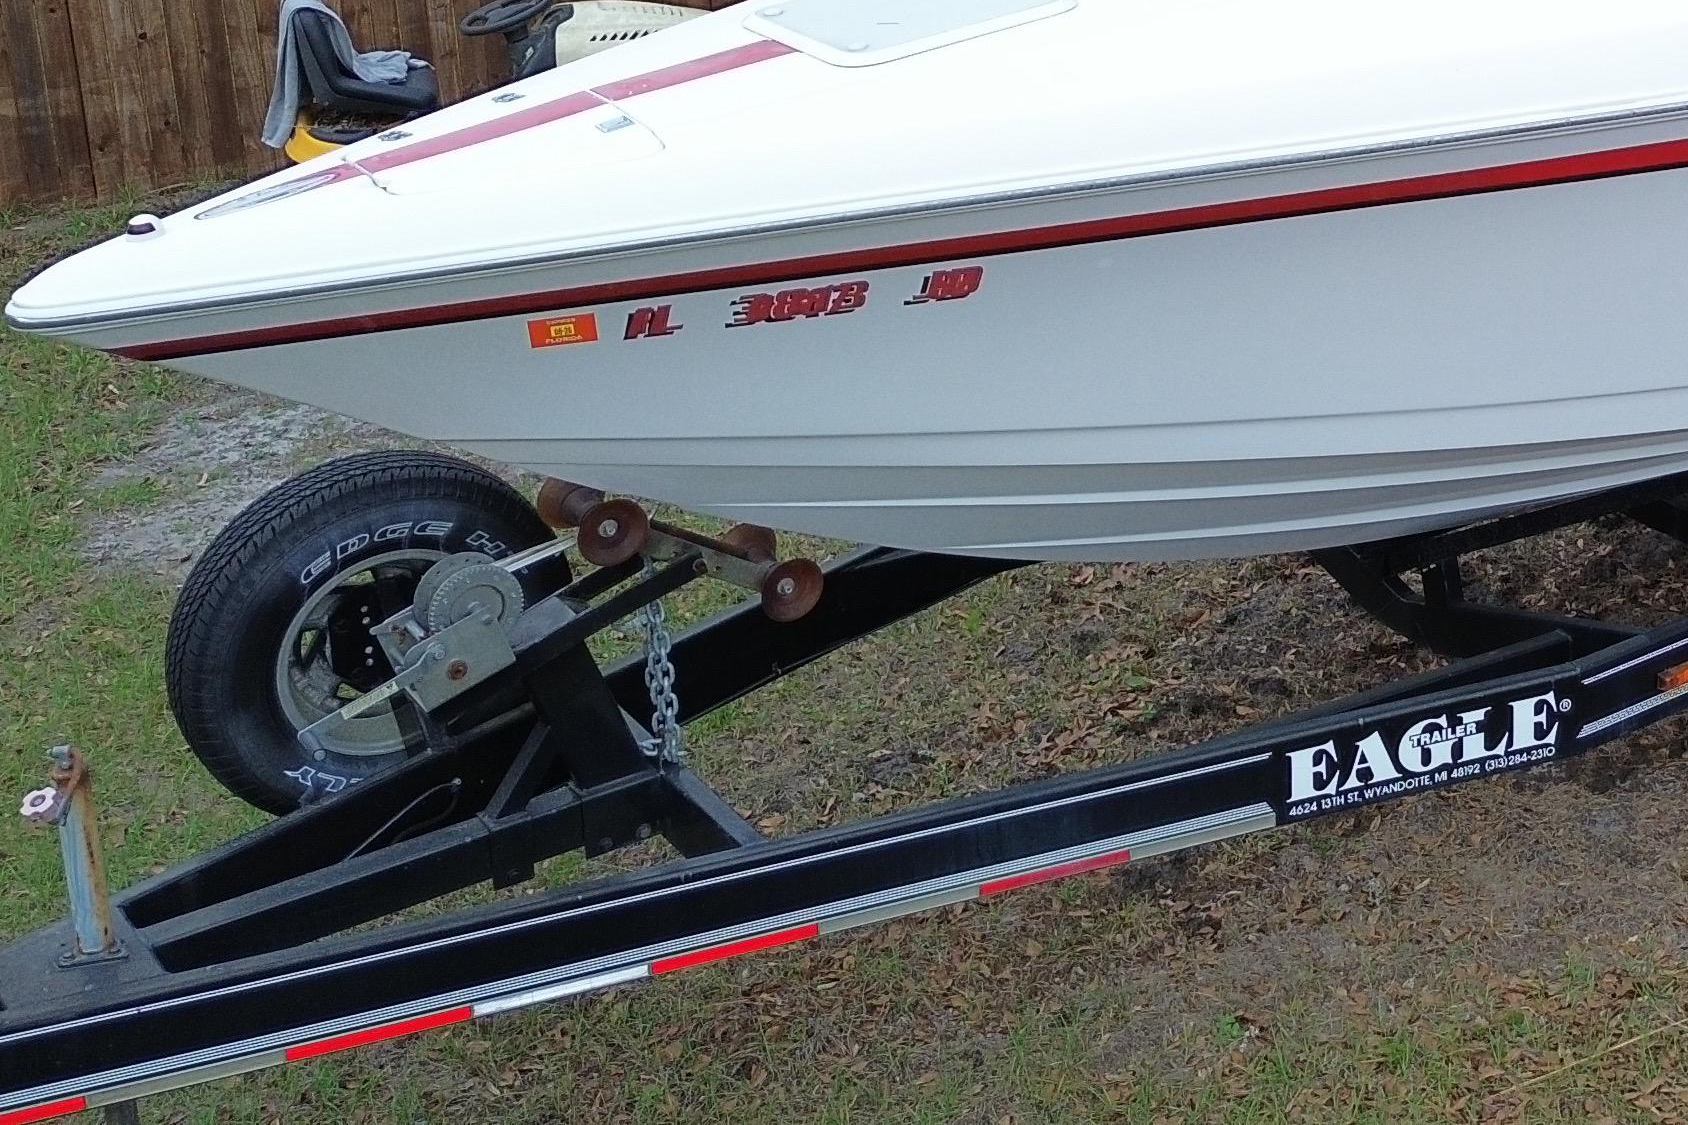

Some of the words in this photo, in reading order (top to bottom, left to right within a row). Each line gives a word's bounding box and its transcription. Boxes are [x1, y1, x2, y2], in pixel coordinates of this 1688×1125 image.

[301, 520, 454, 584] EDGE
[1285, 690, 1560, 803] EAGLE
[1409, 723, 1477, 748] TRAILER
[1289, 801, 1318, 817] 4624
[1321, 795, 1345, 810] 13TH
[1364, 775, 1433, 800] WYANDOTTE,
[1434, 771, 1448, 783] MI
[1450, 763, 1481, 780] 48192
